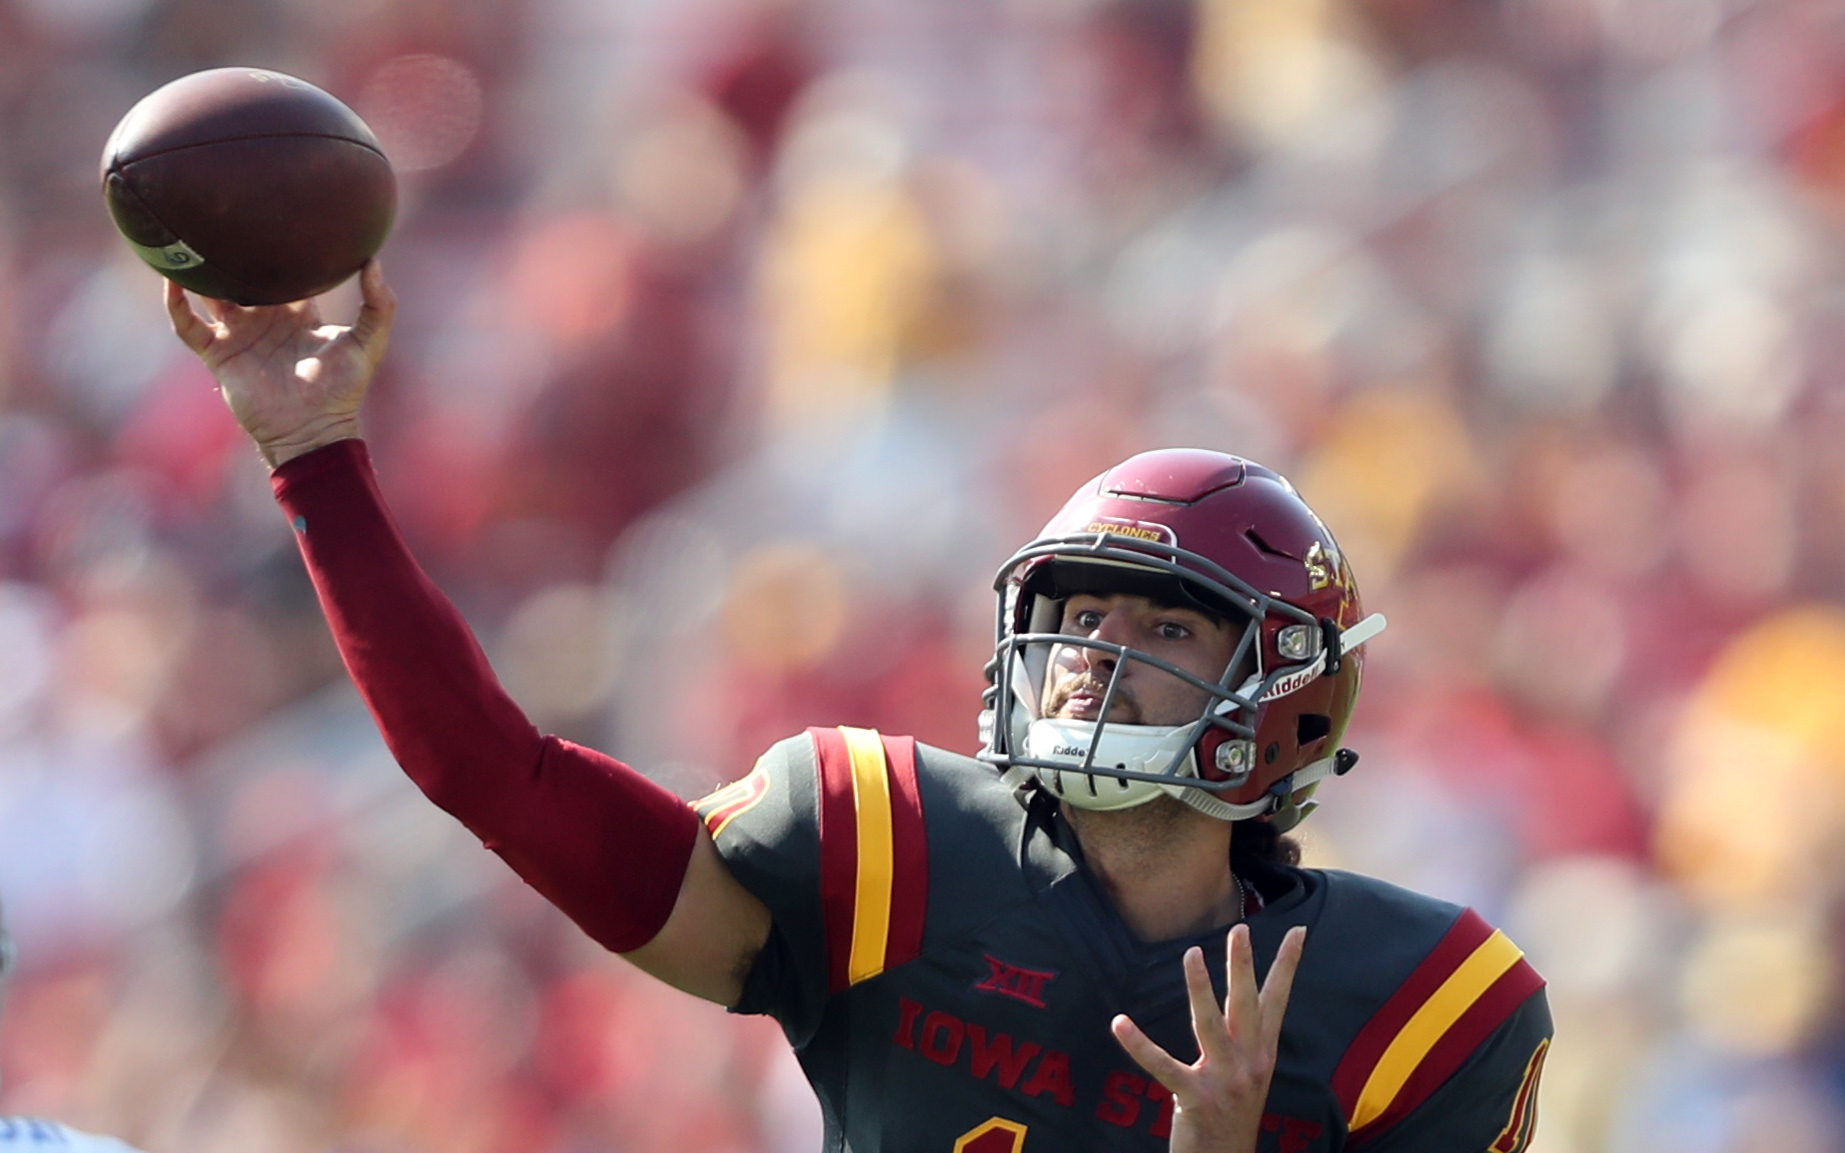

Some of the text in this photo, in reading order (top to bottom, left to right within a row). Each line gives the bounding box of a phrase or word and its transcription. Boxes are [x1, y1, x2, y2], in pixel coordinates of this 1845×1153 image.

[1087, 522, 1162, 542] CYCLONES
[974, 953, 1056, 1010] XII
[892, 997, 1077, 1109] IOWA
